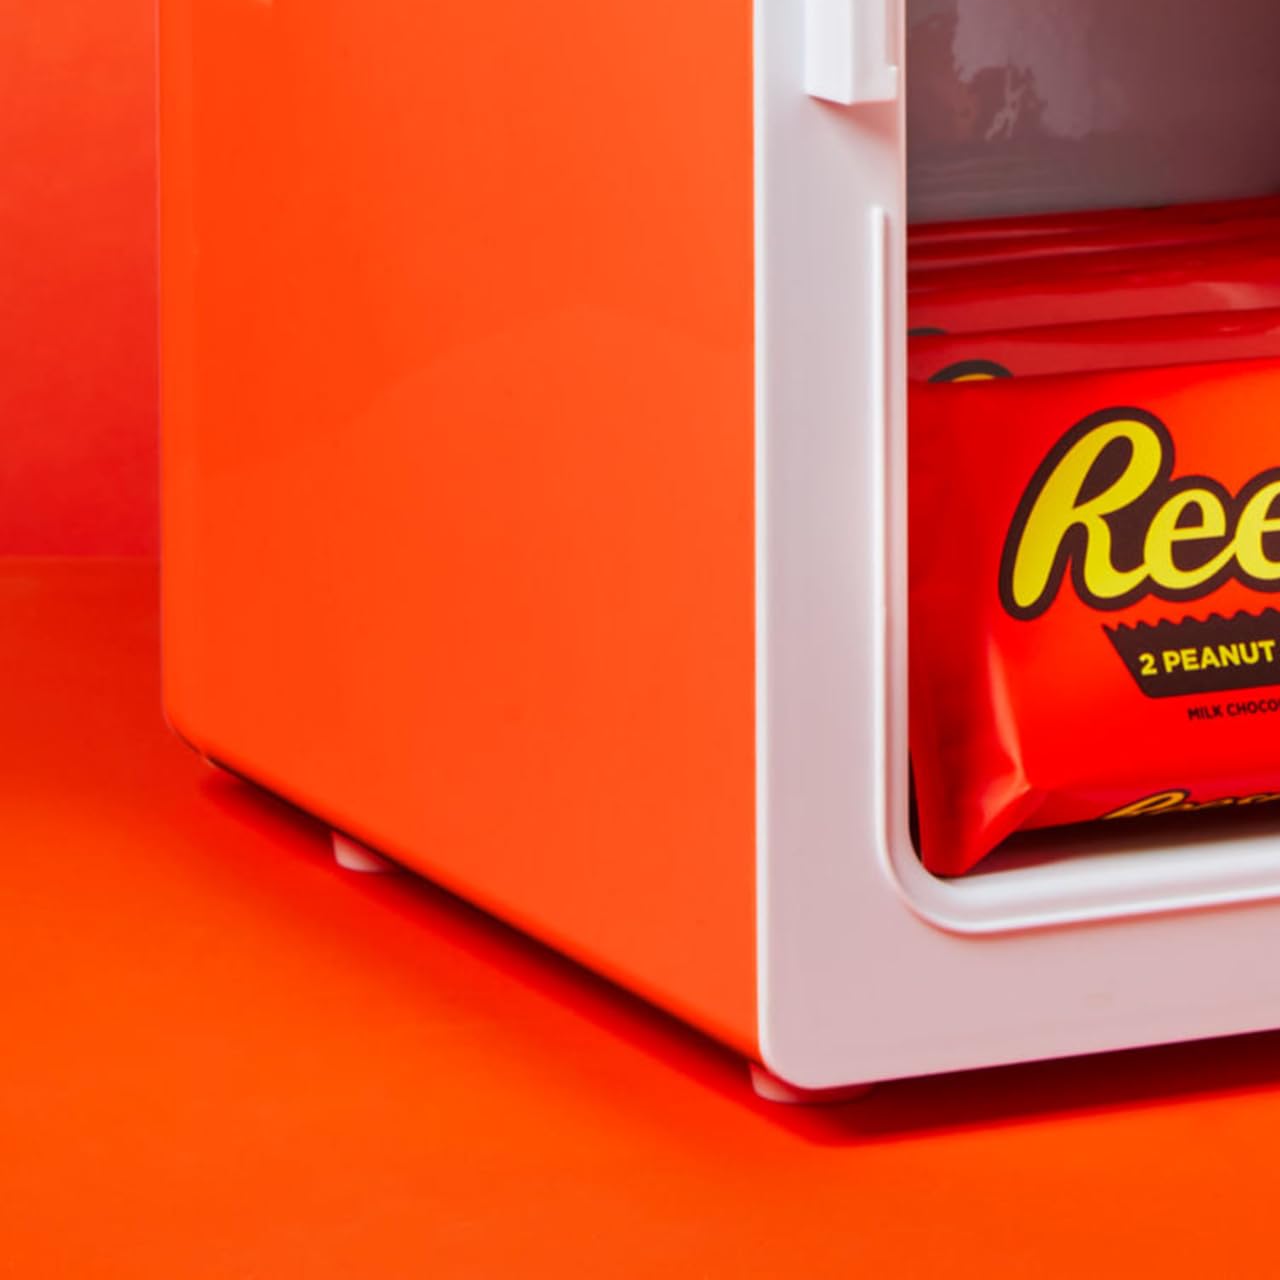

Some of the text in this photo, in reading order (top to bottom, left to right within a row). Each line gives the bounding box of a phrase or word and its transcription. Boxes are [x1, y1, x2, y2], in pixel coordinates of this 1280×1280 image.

[1138, 653, 1158, 676] 2
[1162, 639, 1276, 673] PEANUT
[1187, 705, 1224, 721] MILK
